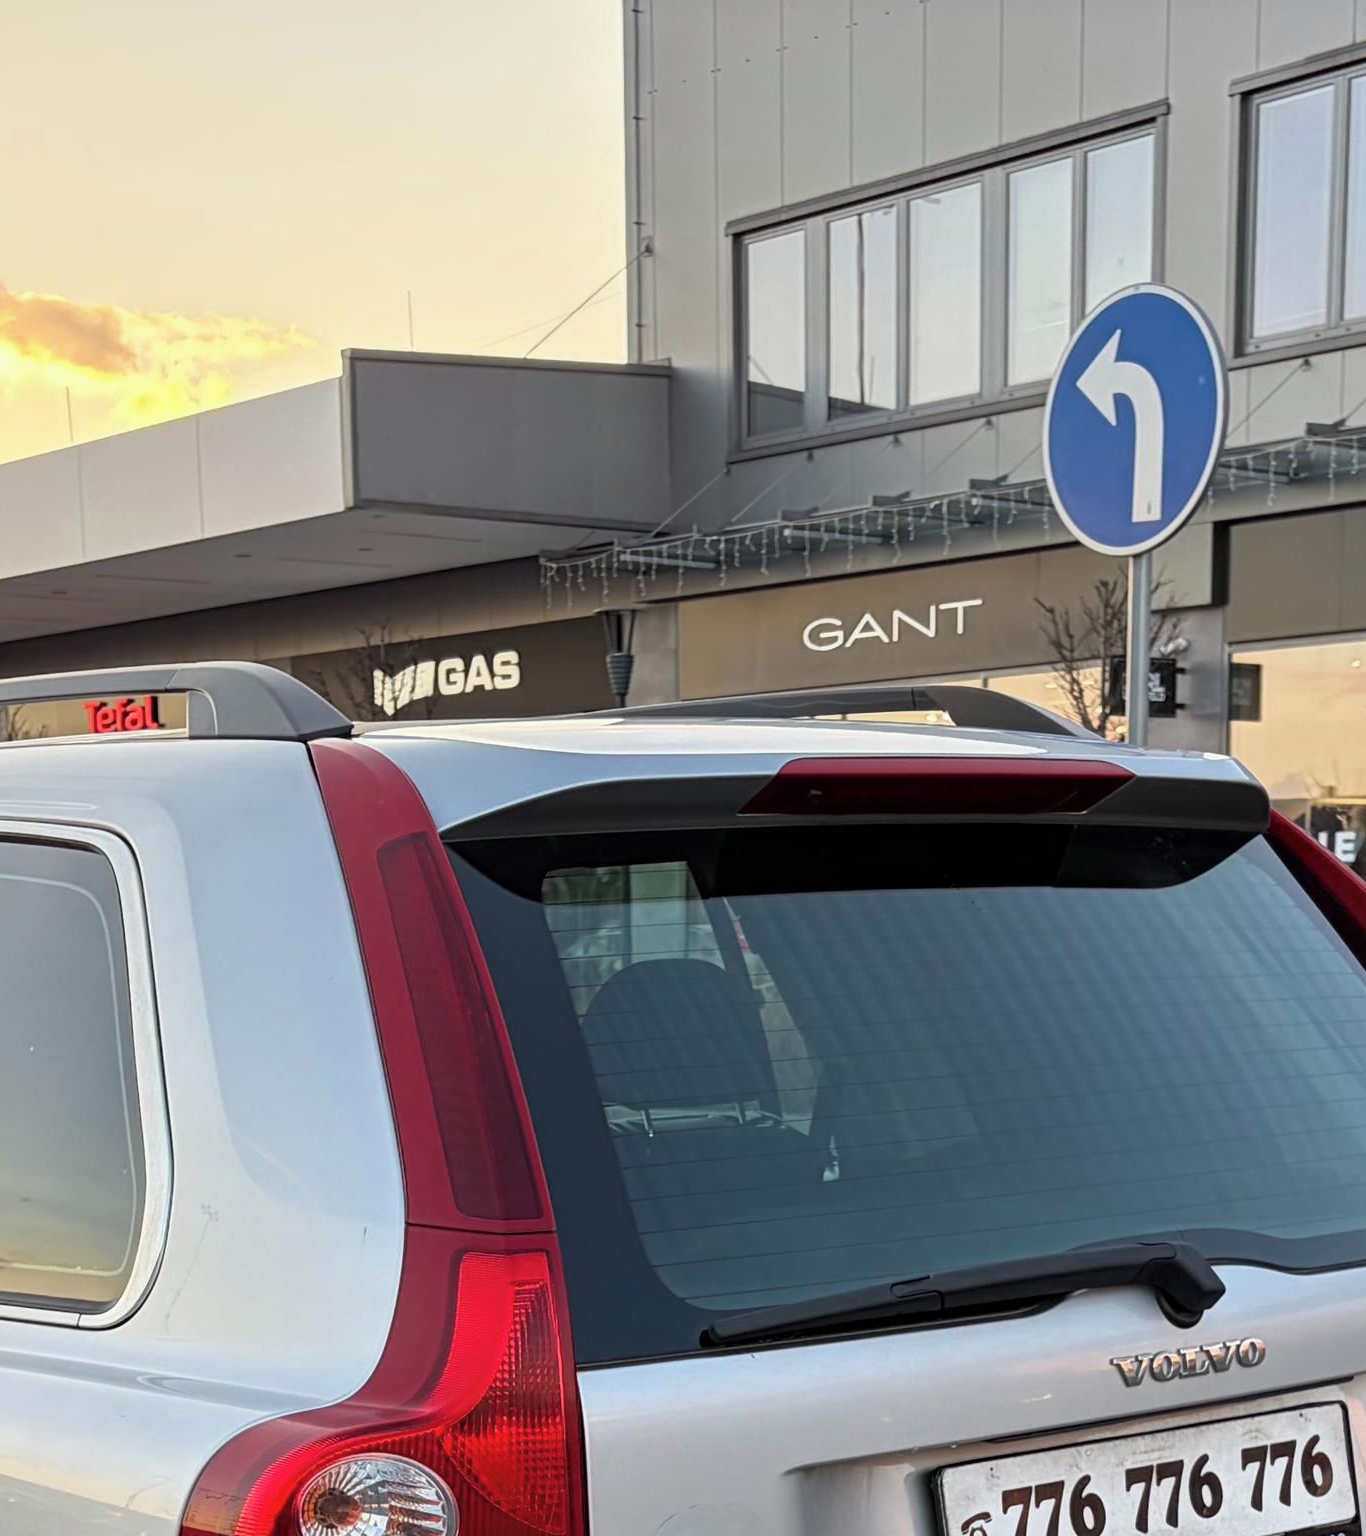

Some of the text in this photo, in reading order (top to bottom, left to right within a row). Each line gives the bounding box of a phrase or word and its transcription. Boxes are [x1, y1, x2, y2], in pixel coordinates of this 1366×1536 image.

[802, 598, 983, 652] GANT
[437, 650, 521, 696] GAS
[83, 694, 160, 733] Tefal
[1109, 1336, 1267, 1388] VOLVO
[1125, 1453, 1223, 1534] 776
[1241, 1434, 1333, 1512] 776
